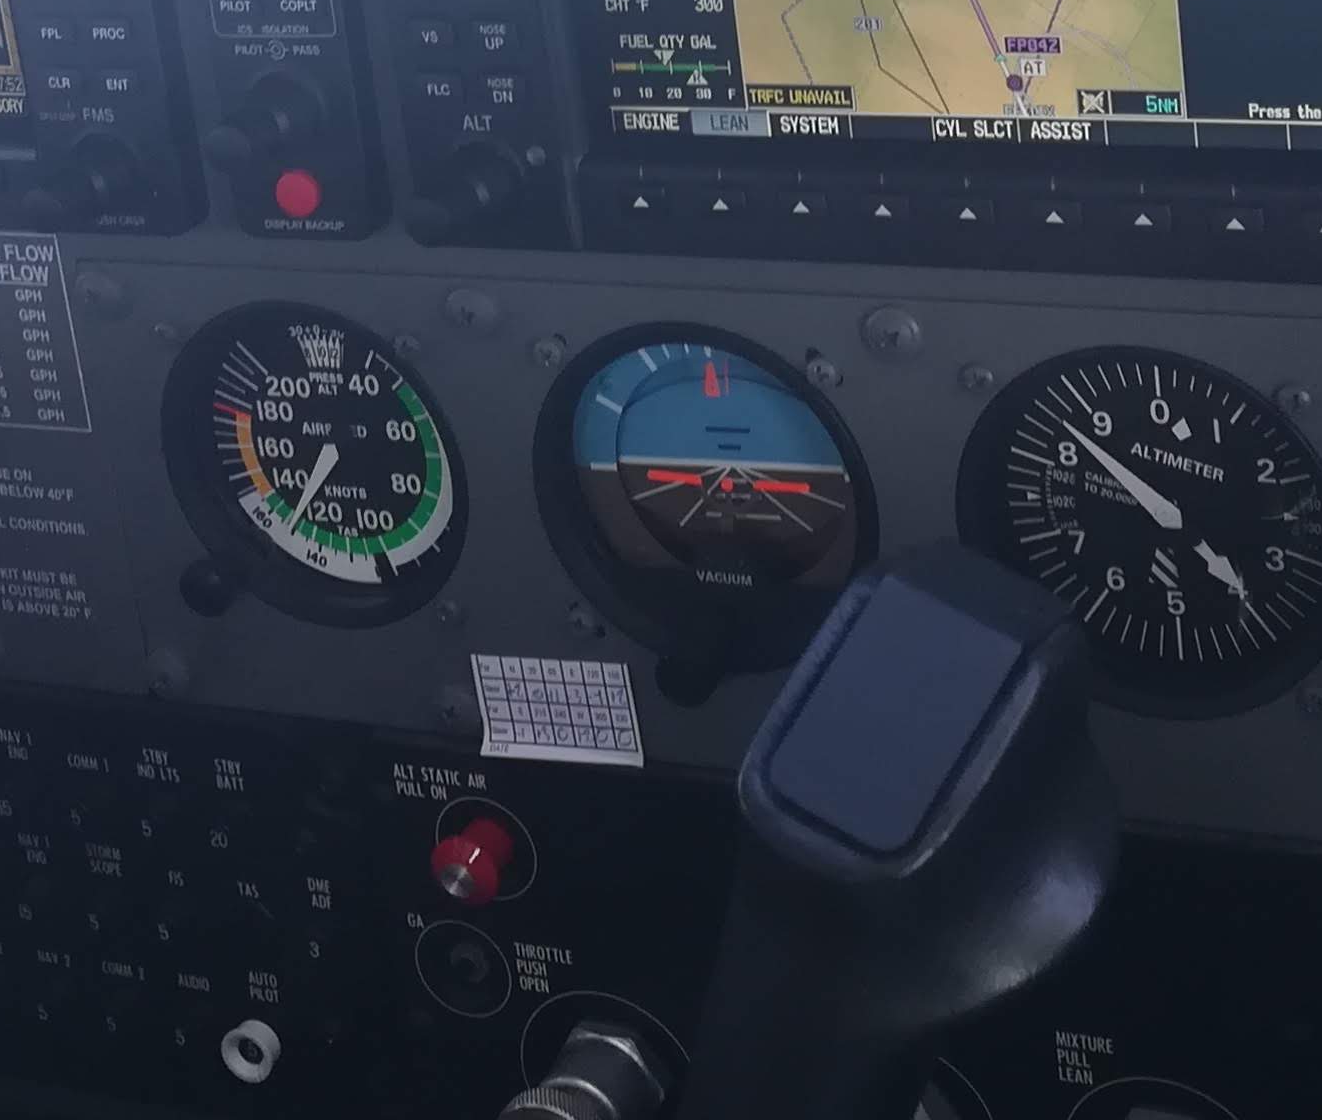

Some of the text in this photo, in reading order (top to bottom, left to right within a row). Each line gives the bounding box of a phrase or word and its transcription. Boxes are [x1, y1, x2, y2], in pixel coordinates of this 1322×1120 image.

[280, 0, 316, 12] COPLT
[623, 112, 680, 130] ENGINE
[1248, 102, 1291, 119] Press
[1297, 104, 1321, 120] the
[711, 114, 749, 131] LEAN
[779, 116, 839, 135] SYSTEM
[935, 119, 1014, 139] CYL SLCT
[1030, 121, 1091, 141] ASSIST
[5, 244, 54, 262] FLOW
[266, 376, 310, 398] 200
[349, 374, 379, 396] 40
[1149, 399, 1170, 424] 0
[386, 421, 416, 441] 60
[1092, 411, 1112, 436] 9
[1130, 442, 1225, 482] ALTIMETER
[391, 474, 420, 494] 80
[696, 570, 753, 586] VACUUM
[393, 763, 486, 790] ALT STATIC AIR
[514, 942, 573, 965] THROTTLE
[1055, 1030, 1114, 1054] MIXTURE
